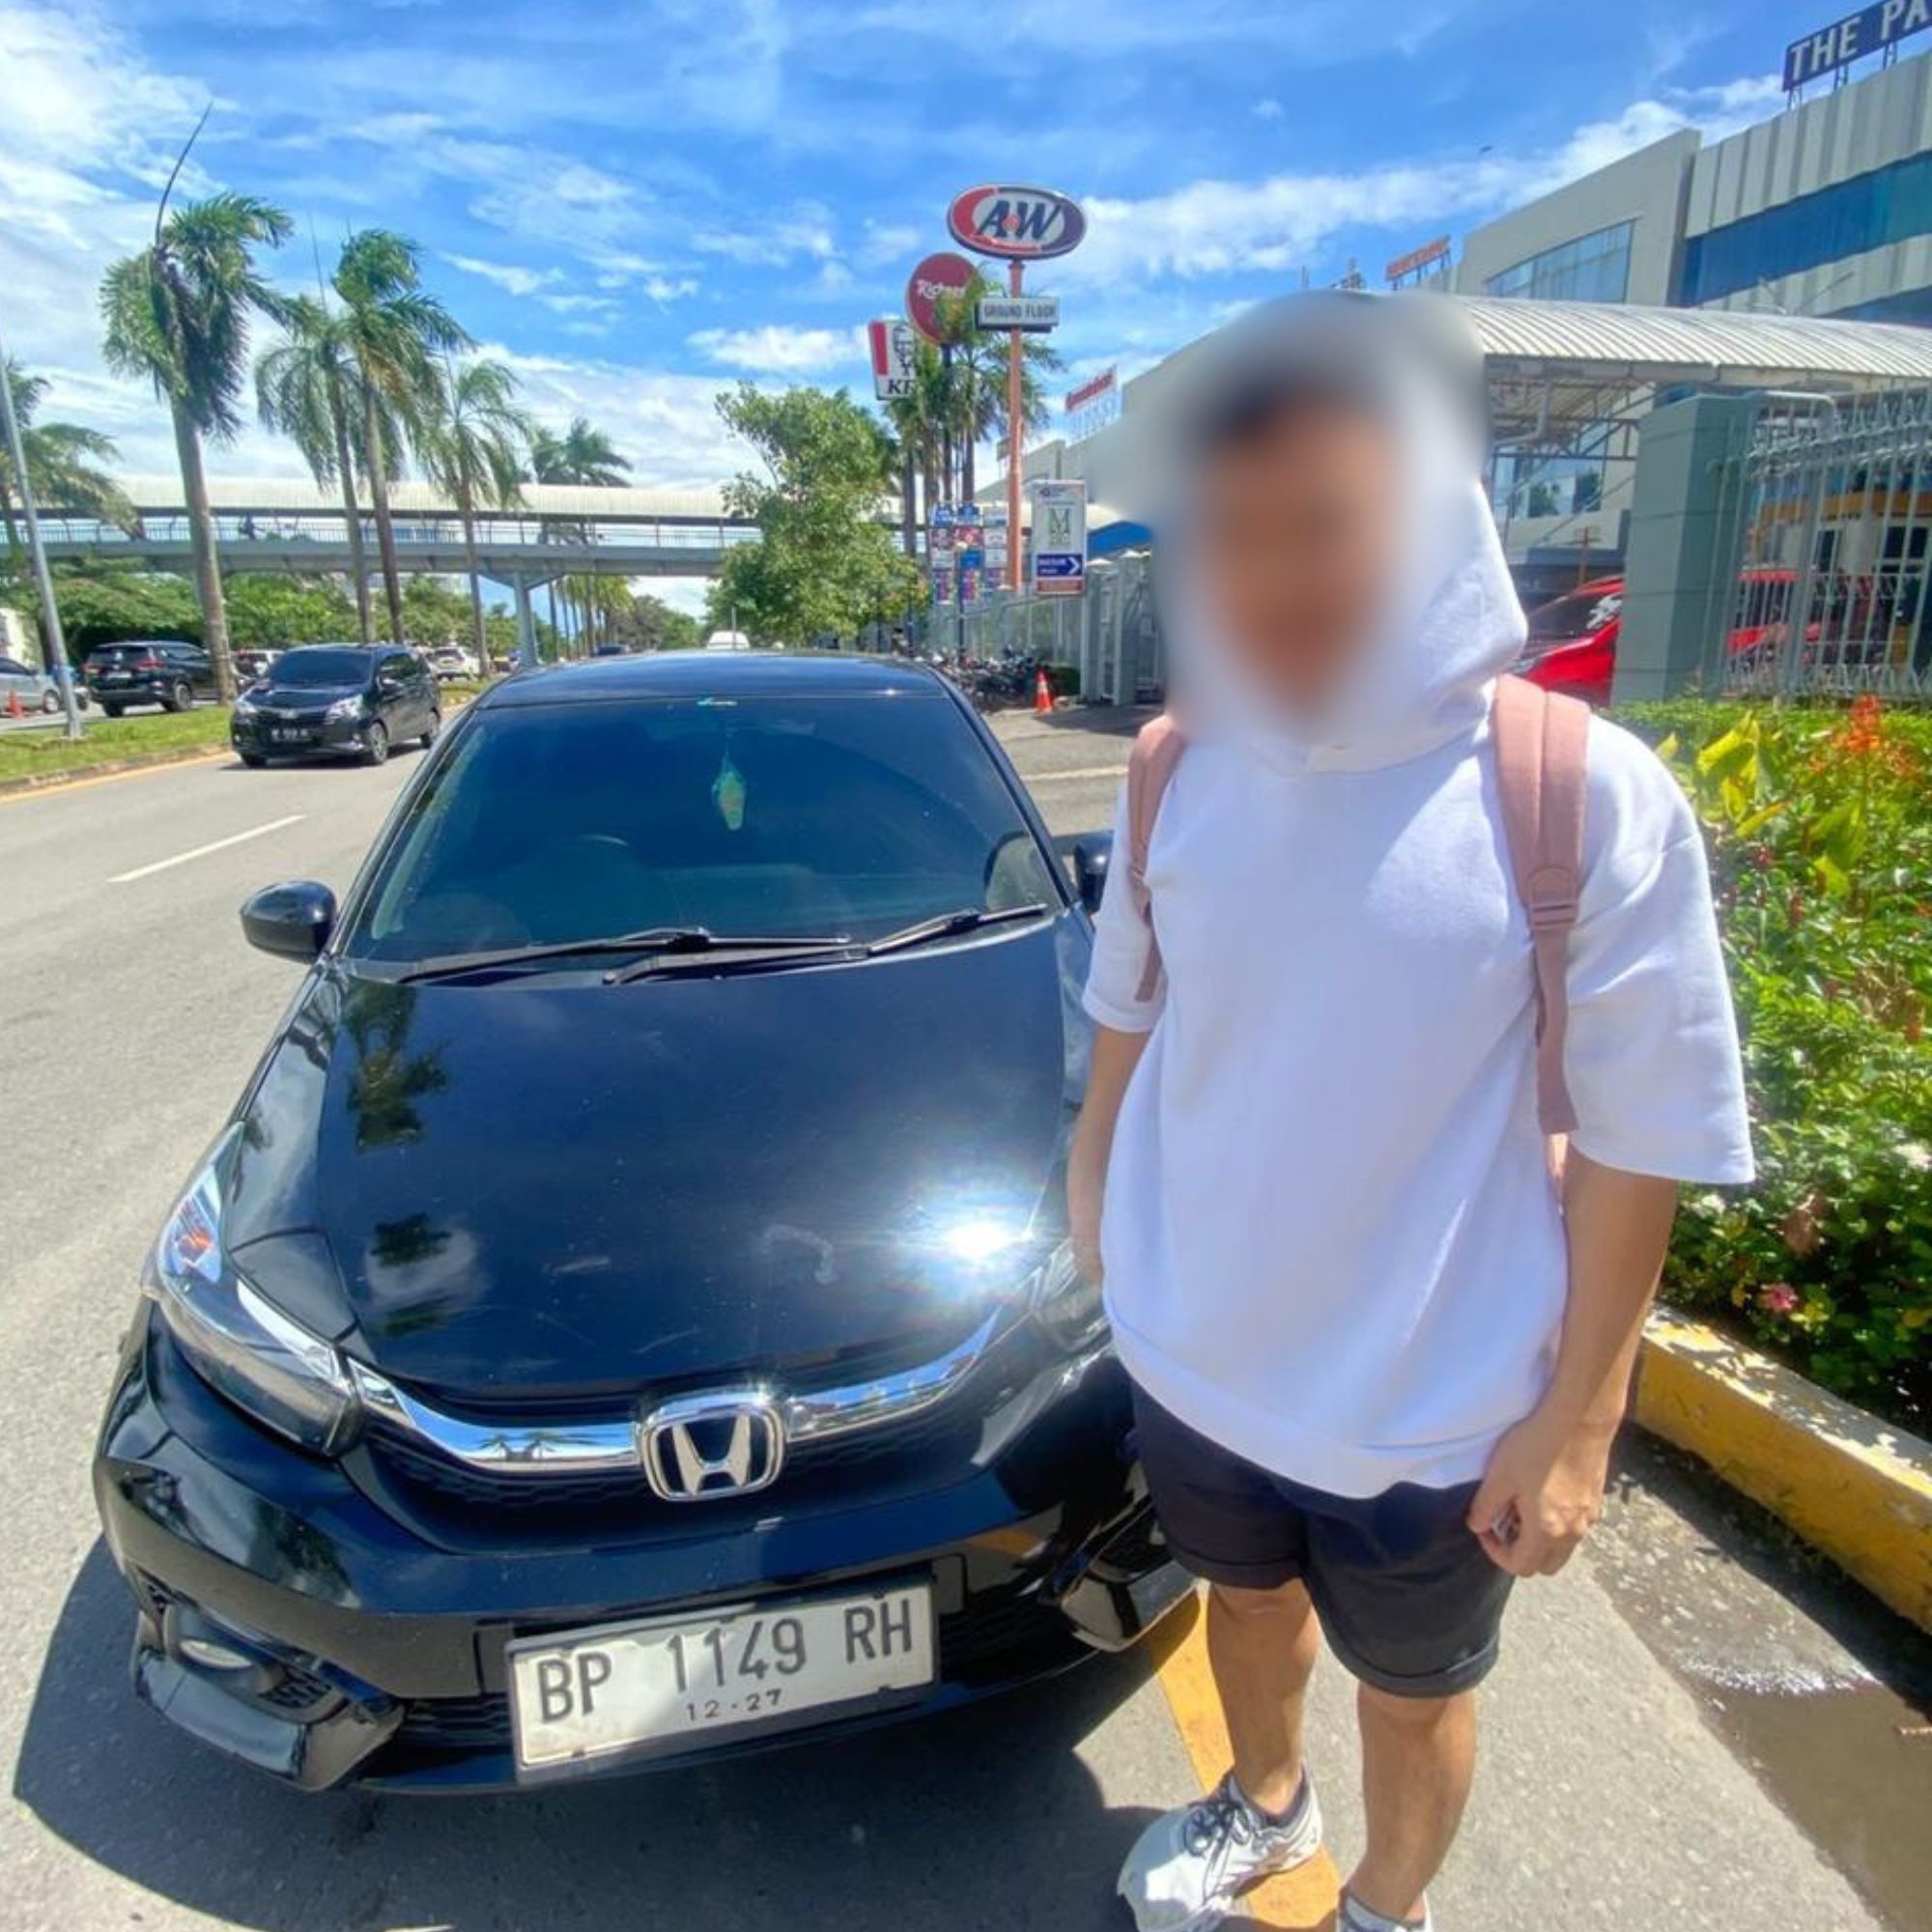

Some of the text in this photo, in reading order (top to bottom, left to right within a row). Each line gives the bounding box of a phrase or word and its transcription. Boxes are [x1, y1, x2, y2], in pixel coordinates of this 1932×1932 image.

[1790, 0, 1931, 81] THE PA
[983, 303, 1056, 318] GROUND FLOOR
[887, 379, 920, 395] KF
[537, 1598, 913, 1723] BP 1149 RH
